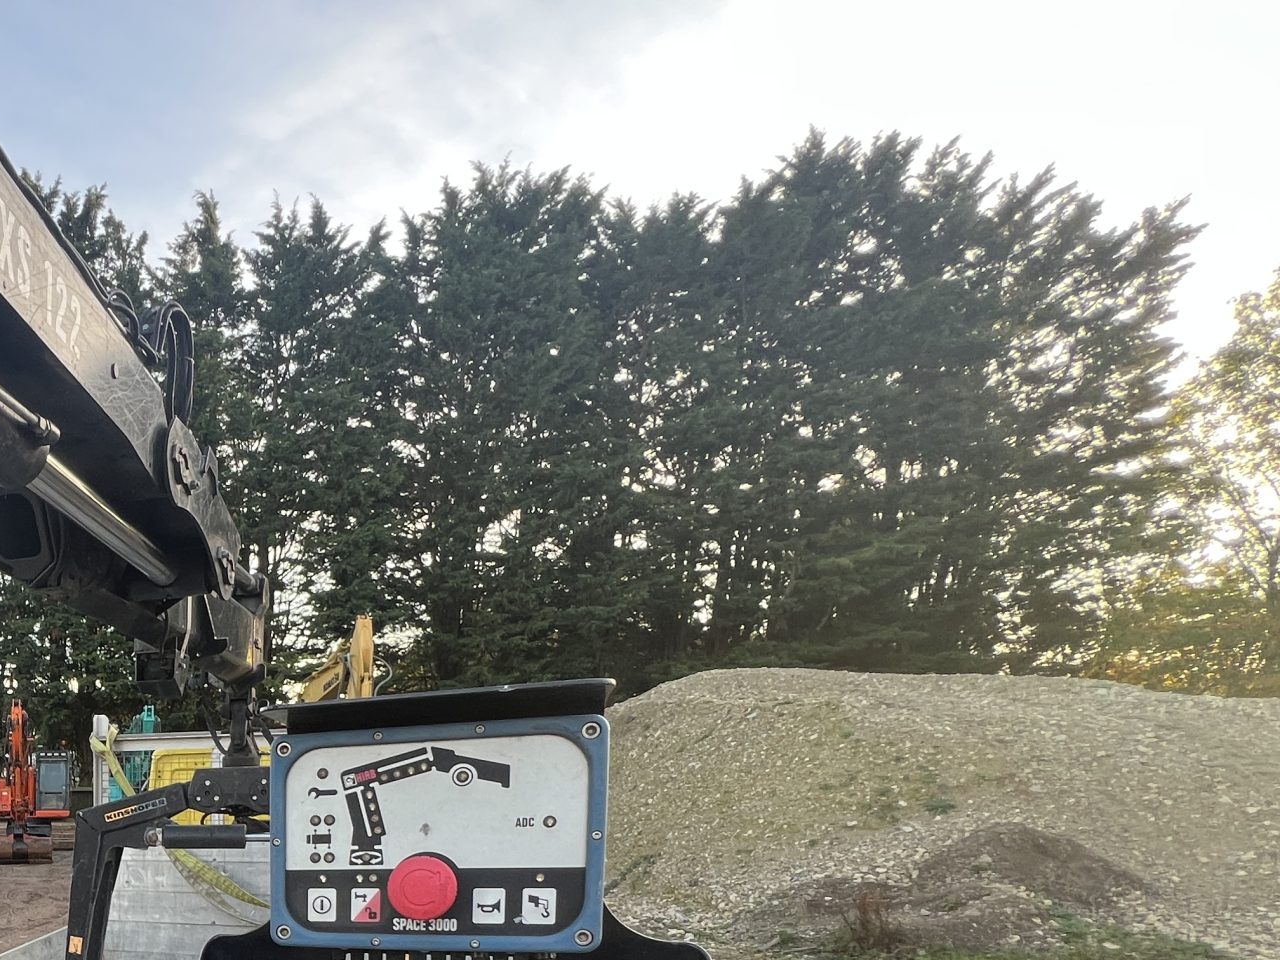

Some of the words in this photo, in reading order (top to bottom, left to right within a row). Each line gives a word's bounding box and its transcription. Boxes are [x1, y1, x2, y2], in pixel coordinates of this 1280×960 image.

[44, 260, 81, 361] 122
[515, 817, 535, 829] ADC
[392, 918, 426, 931] SPACE
[428, 918, 458, 931] 3000
